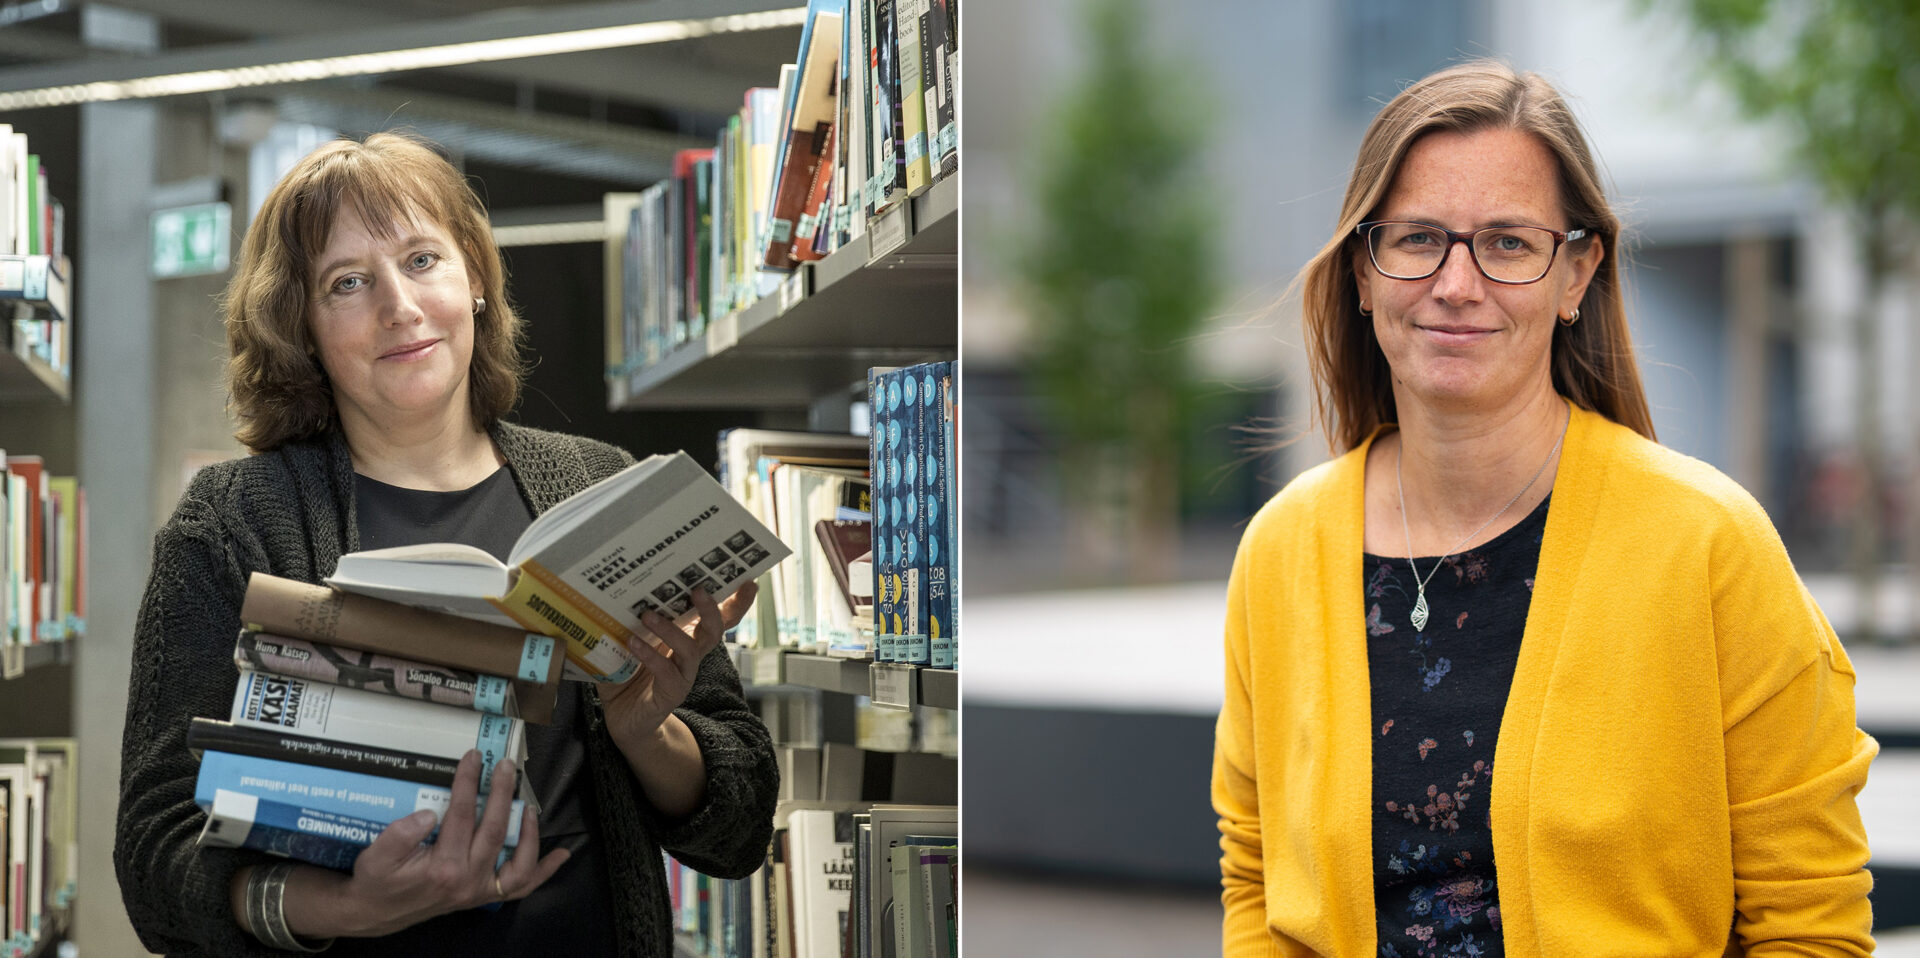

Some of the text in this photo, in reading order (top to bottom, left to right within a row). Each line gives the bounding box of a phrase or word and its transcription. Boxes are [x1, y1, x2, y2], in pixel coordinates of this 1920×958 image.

[596, 504, 721, 591] KEELEKORRALDUS
[587, 556, 628, 584] EESTI
[255, 641, 278, 655] Huno
[408, 668, 477, 694] Sõnaloo raamat
[247, 673, 265, 721] EESTI KEELE
[284, 680, 306, 728] RAAMAT
[280, 739, 332, 758] riigikeeleks
[332, 745, 363, 764] keelest
[364, 750, 409, 770] Talurahva
[289, 781, 309, 796] keel
[311, 785, 335, 799] eesti
[336, 788, 348, 801] ja
[349, 790, 396, 809] Eestlased
[297, 816, 368, 844] KOHANIMED
